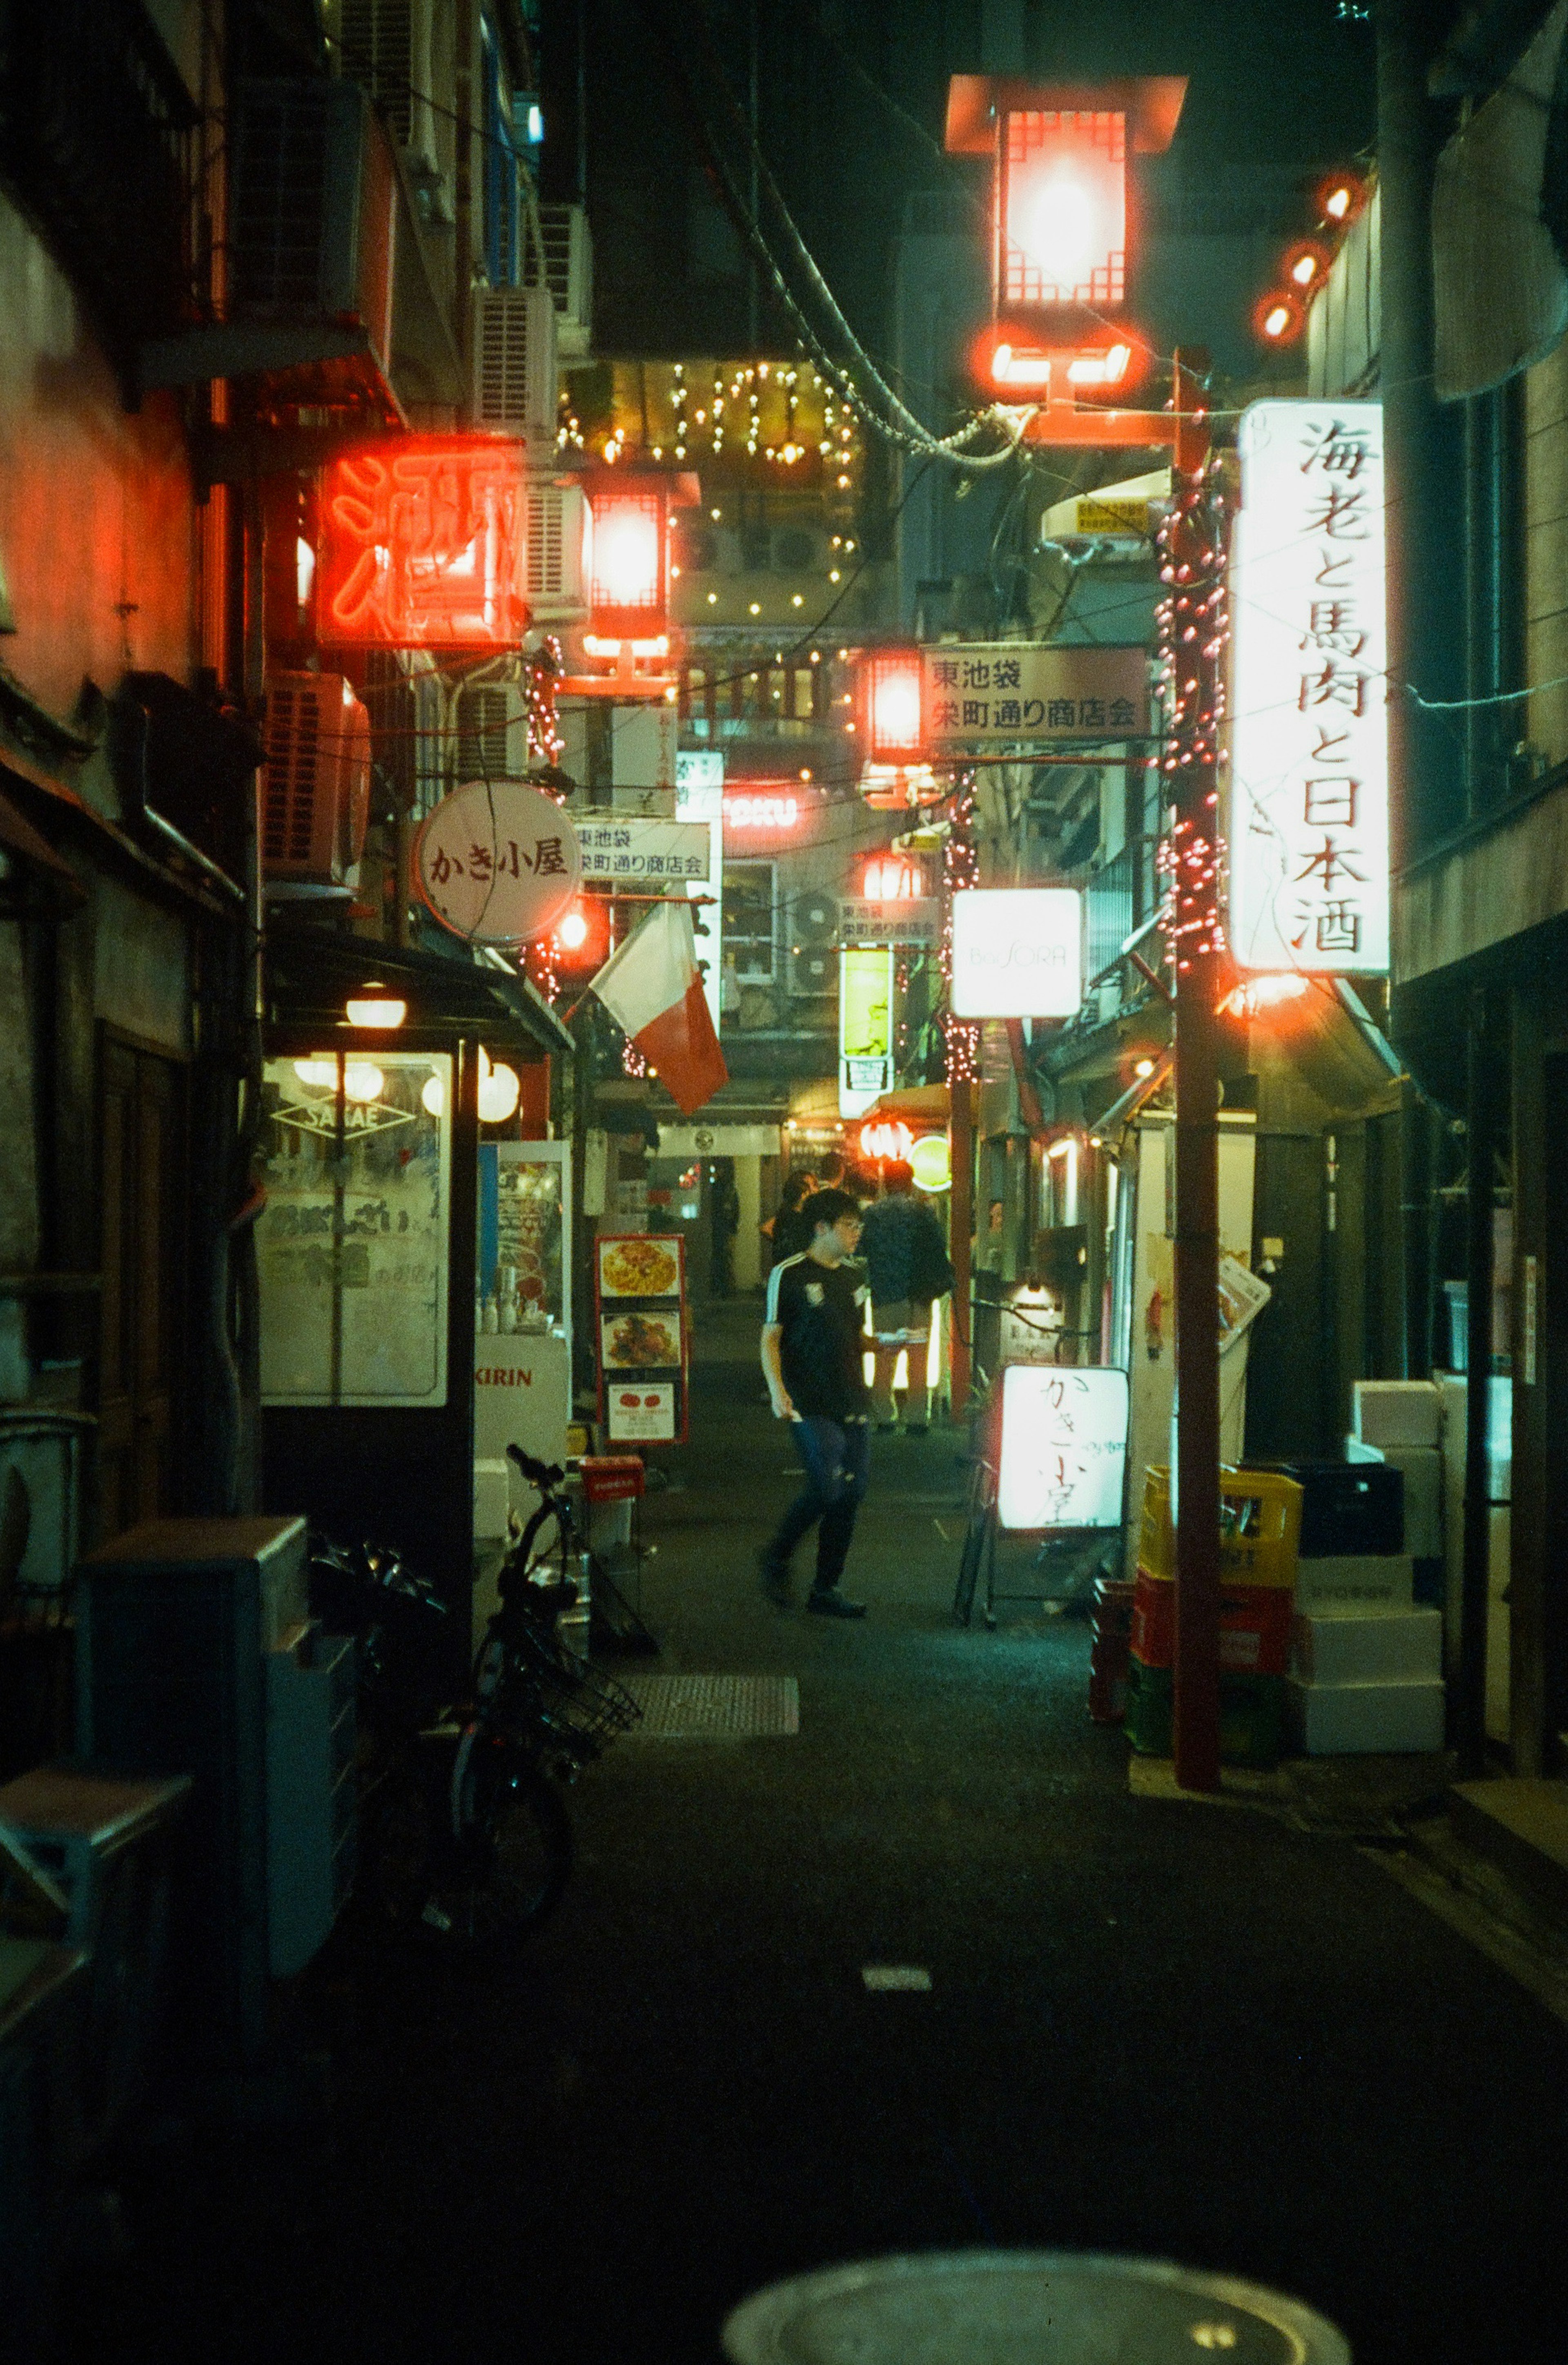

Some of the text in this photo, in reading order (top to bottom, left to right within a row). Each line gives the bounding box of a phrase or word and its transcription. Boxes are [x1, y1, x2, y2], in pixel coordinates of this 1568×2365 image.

[933, 660, 1021, 689] 東池袋
[1292, 420, 1380, 952] 海老と馬肉と日本酒
[933, 698, 1136, 729] 栄町通り商店会
[430, 836, 568, 885] かき小屋
[1000, 939, 1067, 969] SORA
